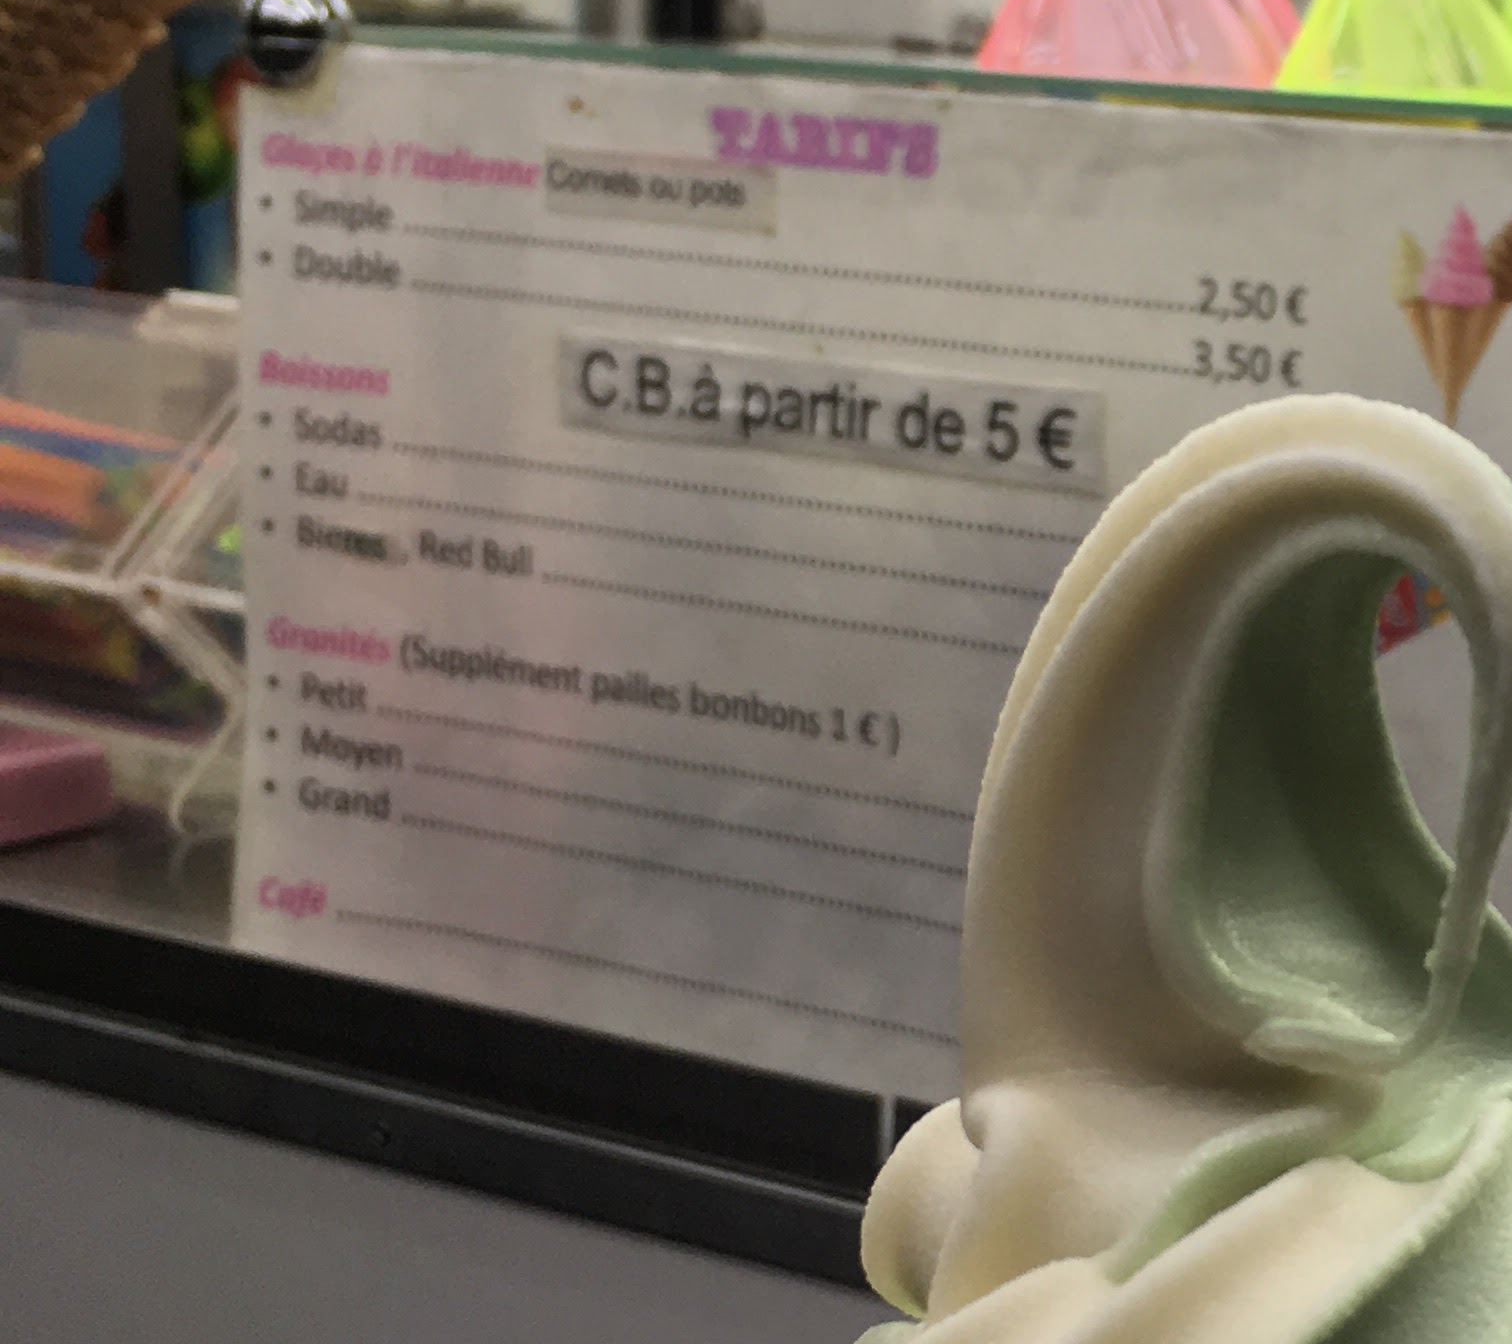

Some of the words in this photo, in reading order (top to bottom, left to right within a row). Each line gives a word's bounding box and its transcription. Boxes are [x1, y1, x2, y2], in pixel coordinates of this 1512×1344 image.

[390, 140, 542, 190] l'italienne
[710, 106, 938, 178] TARIFS
[547, 158, 643, 199] Cornets
[648, 173, 683, 203] ou
[689, 176, 747, 208] pots
[294, 190, 393, 233] Simple
[293, 244, 402, 290] Double
[259, 349, 389, 396] Boissons
[294, 407, 382, 449] Sodas
[738, 382, 882, 439] partir
[898, 386, 965, 456] de
[981, 398, 1021, 462] 5
[1036, 408, 1079, 471] €
[295, 460, 348, 499] Eau
[418, 528, 474, 569] Red
[481, 538, 533, 577] Bull
[264, 614, 392, 664] Granités
[590, 668, 680, 714] pailles
[688, 680, 822, 739] bonbons
[300, 671, 367, 712] Petit
[301, 725, 403, 771] Moyen
[298, 775, 392, 822] Grand
[258, 876, 328, 919] Café
